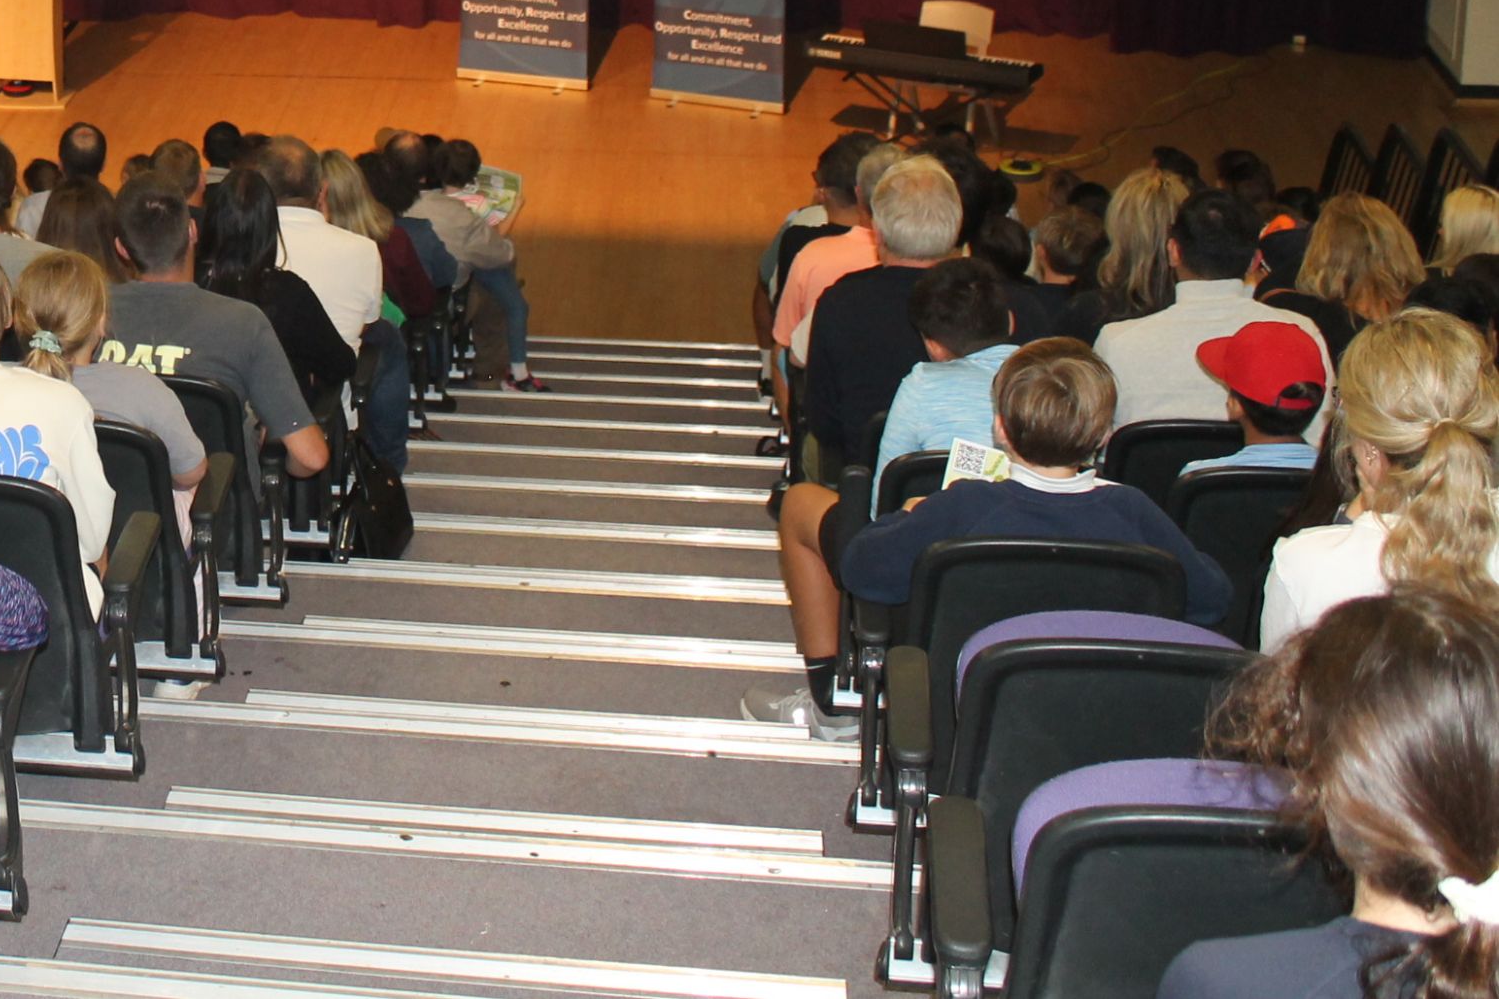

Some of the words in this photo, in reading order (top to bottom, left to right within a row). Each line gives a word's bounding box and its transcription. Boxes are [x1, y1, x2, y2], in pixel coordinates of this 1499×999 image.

[526, 7, 564, 20] Respect
[567, 11, 586, 22] and
[497, 19, 548, 33] Excellence
[720, 28, 759, 42] Respect
[762, 31, 781, 44] and
[691, 40, 744, 55] Excellence
